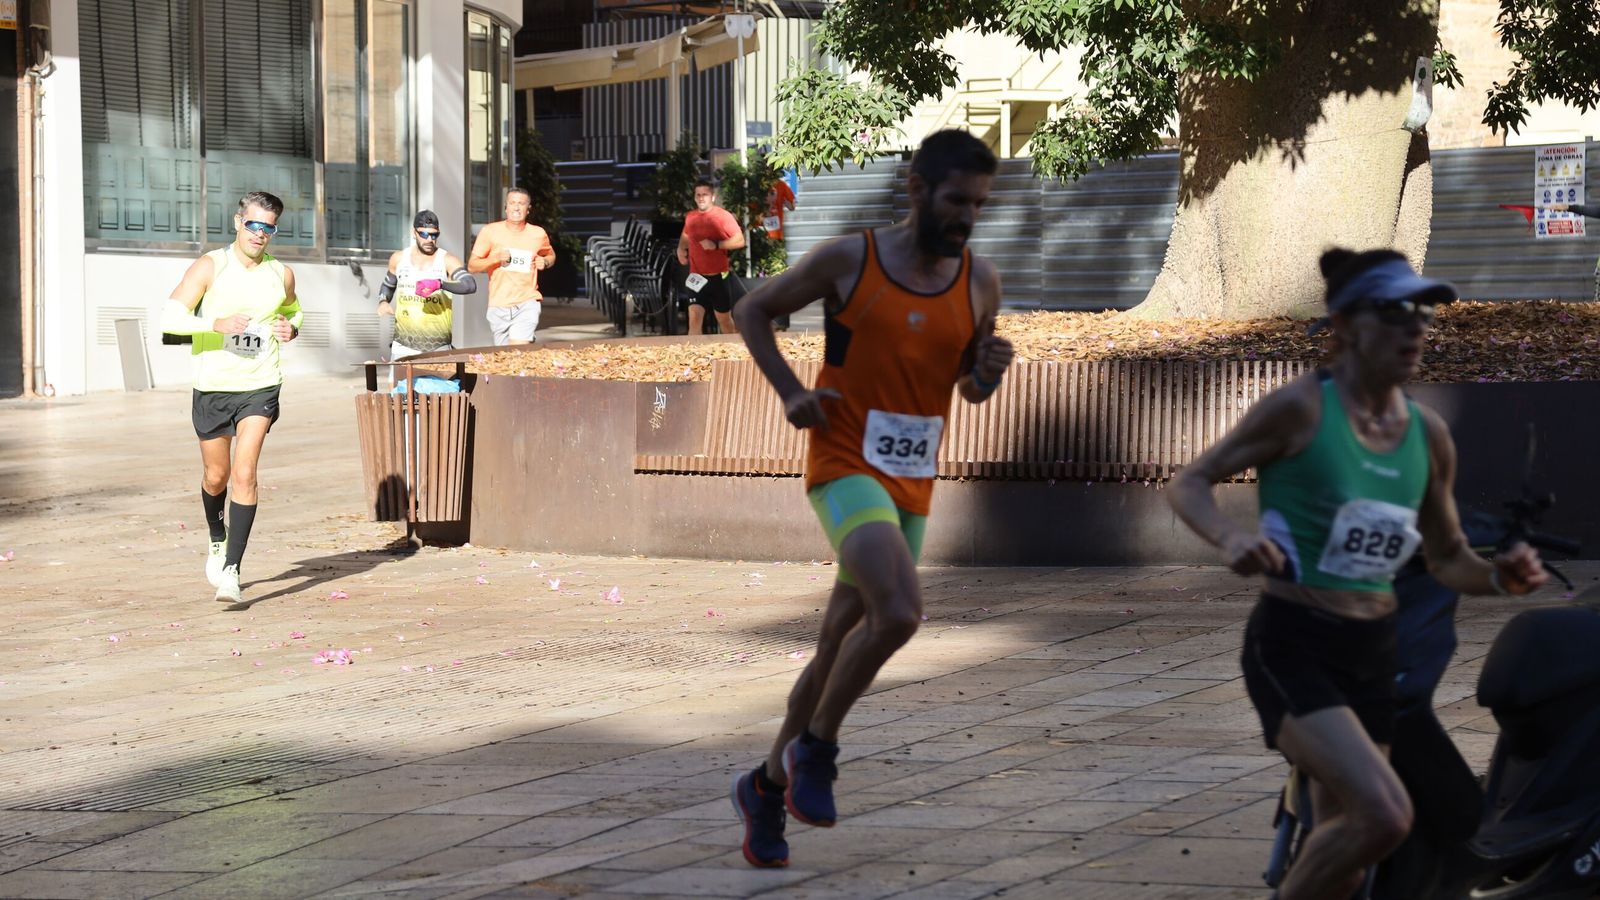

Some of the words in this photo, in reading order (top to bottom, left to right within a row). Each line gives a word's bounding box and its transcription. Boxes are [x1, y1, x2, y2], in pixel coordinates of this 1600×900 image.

[231, 334, 261, 348] 111
[876, 435, 928, 458] 334
[1343, 527, 1404, 560] 828
